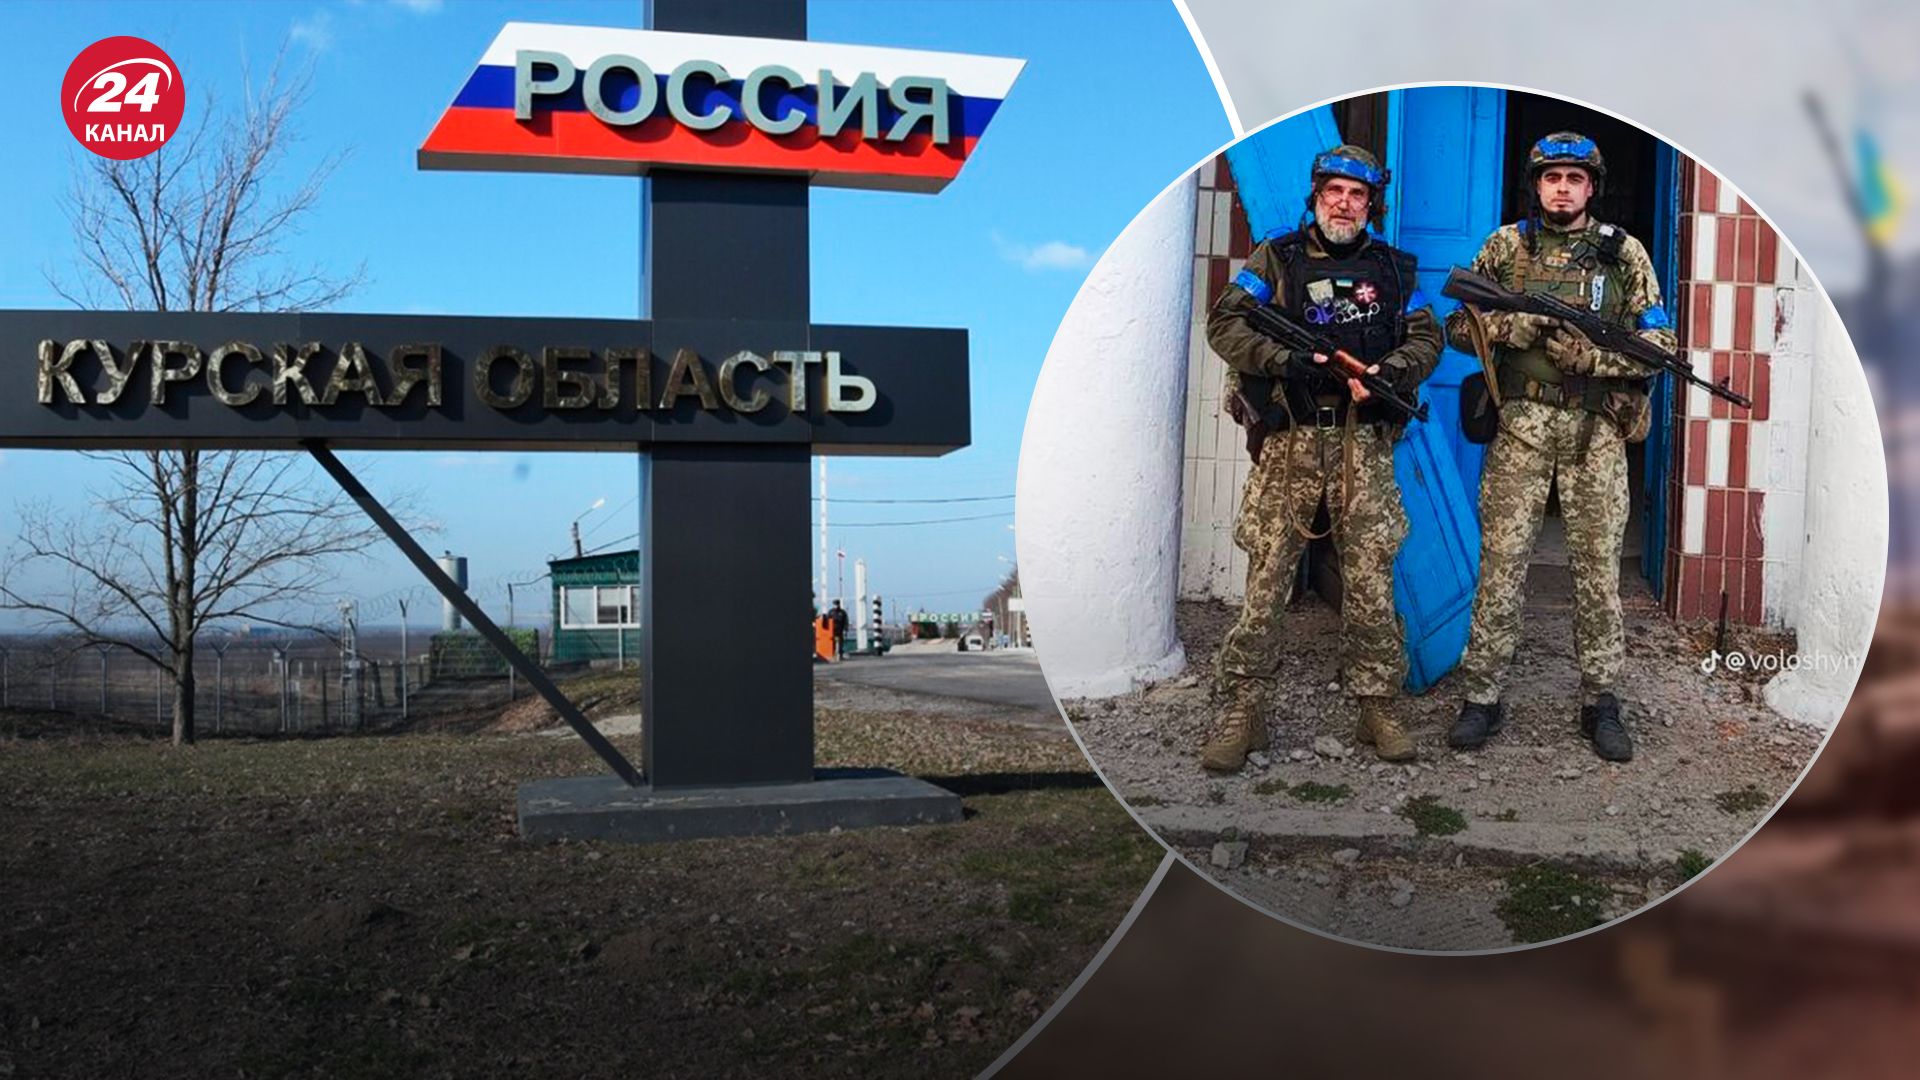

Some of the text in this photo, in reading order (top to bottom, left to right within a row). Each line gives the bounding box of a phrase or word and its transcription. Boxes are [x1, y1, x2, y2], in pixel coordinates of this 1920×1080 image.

[514, 49, 950, 145] РОССИЯ
[38, 339, 878, 413] КУРСКАЯ ОБЛАСТЬ
